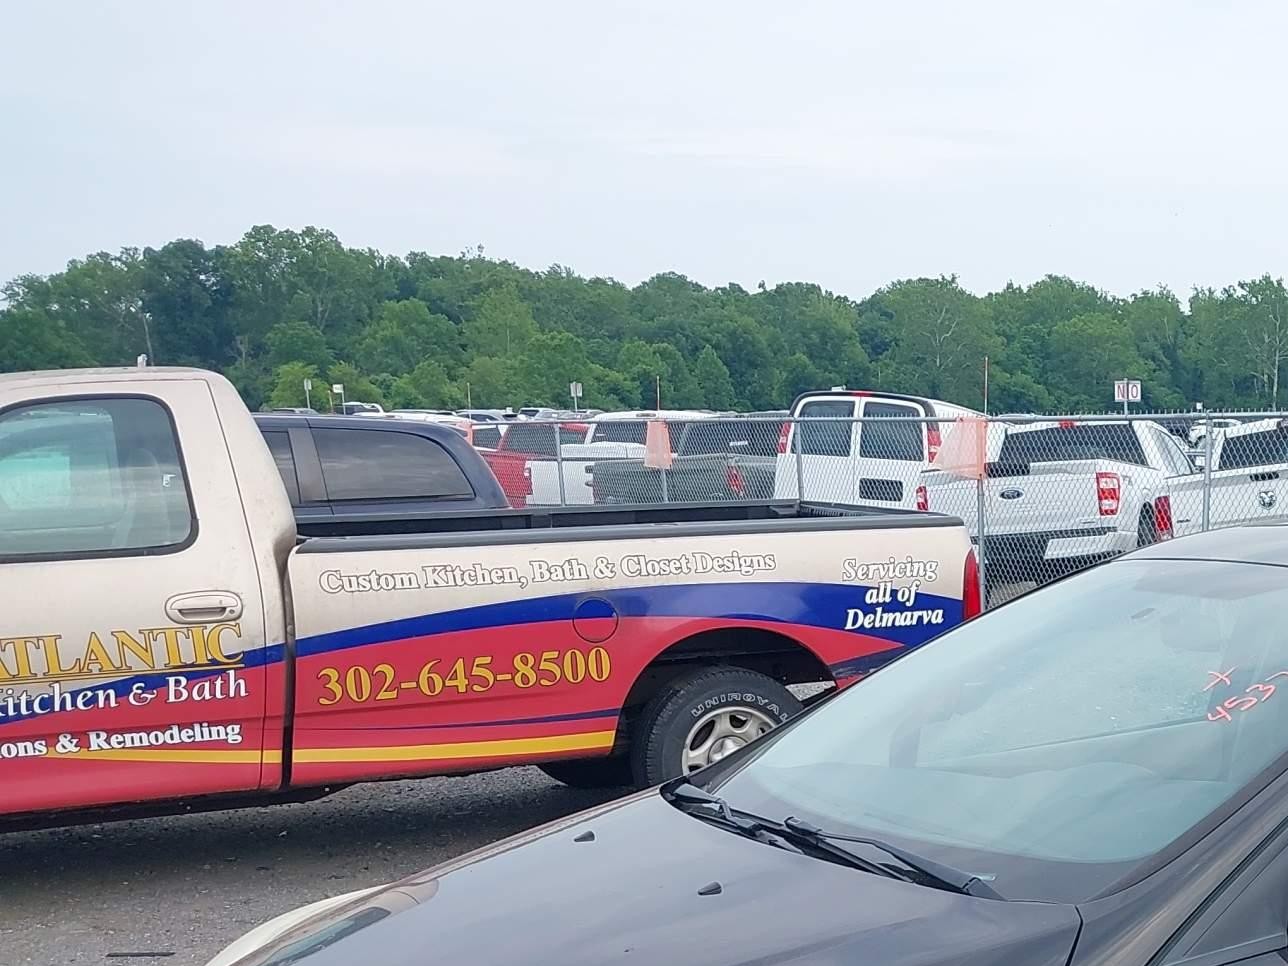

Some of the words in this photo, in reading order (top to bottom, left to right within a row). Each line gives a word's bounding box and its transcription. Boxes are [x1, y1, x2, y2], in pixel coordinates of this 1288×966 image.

[319, 569, 419, 593] Custom
[423, 561, 528, 589] Kitchen,
[530, 558, 588, 583] Bath
[593, 557, 615, 577] &
[620, 553, 690, 576] Closet
[693, 551, 776, 575] Designs
[842, 556, 939, 582] Servicing
[865, 582, 892, 604] all
[897, 580, 921, 606] of
[844, 608, 944, 630] Delmarva
[129, 683, 157, 706] &
[166, 670, 249, 703] Bath
[317, 646, 613, 706] 302-645-8500
[55, 732, 80, 753] &
[88, 722, 243, 751] Remodeling
